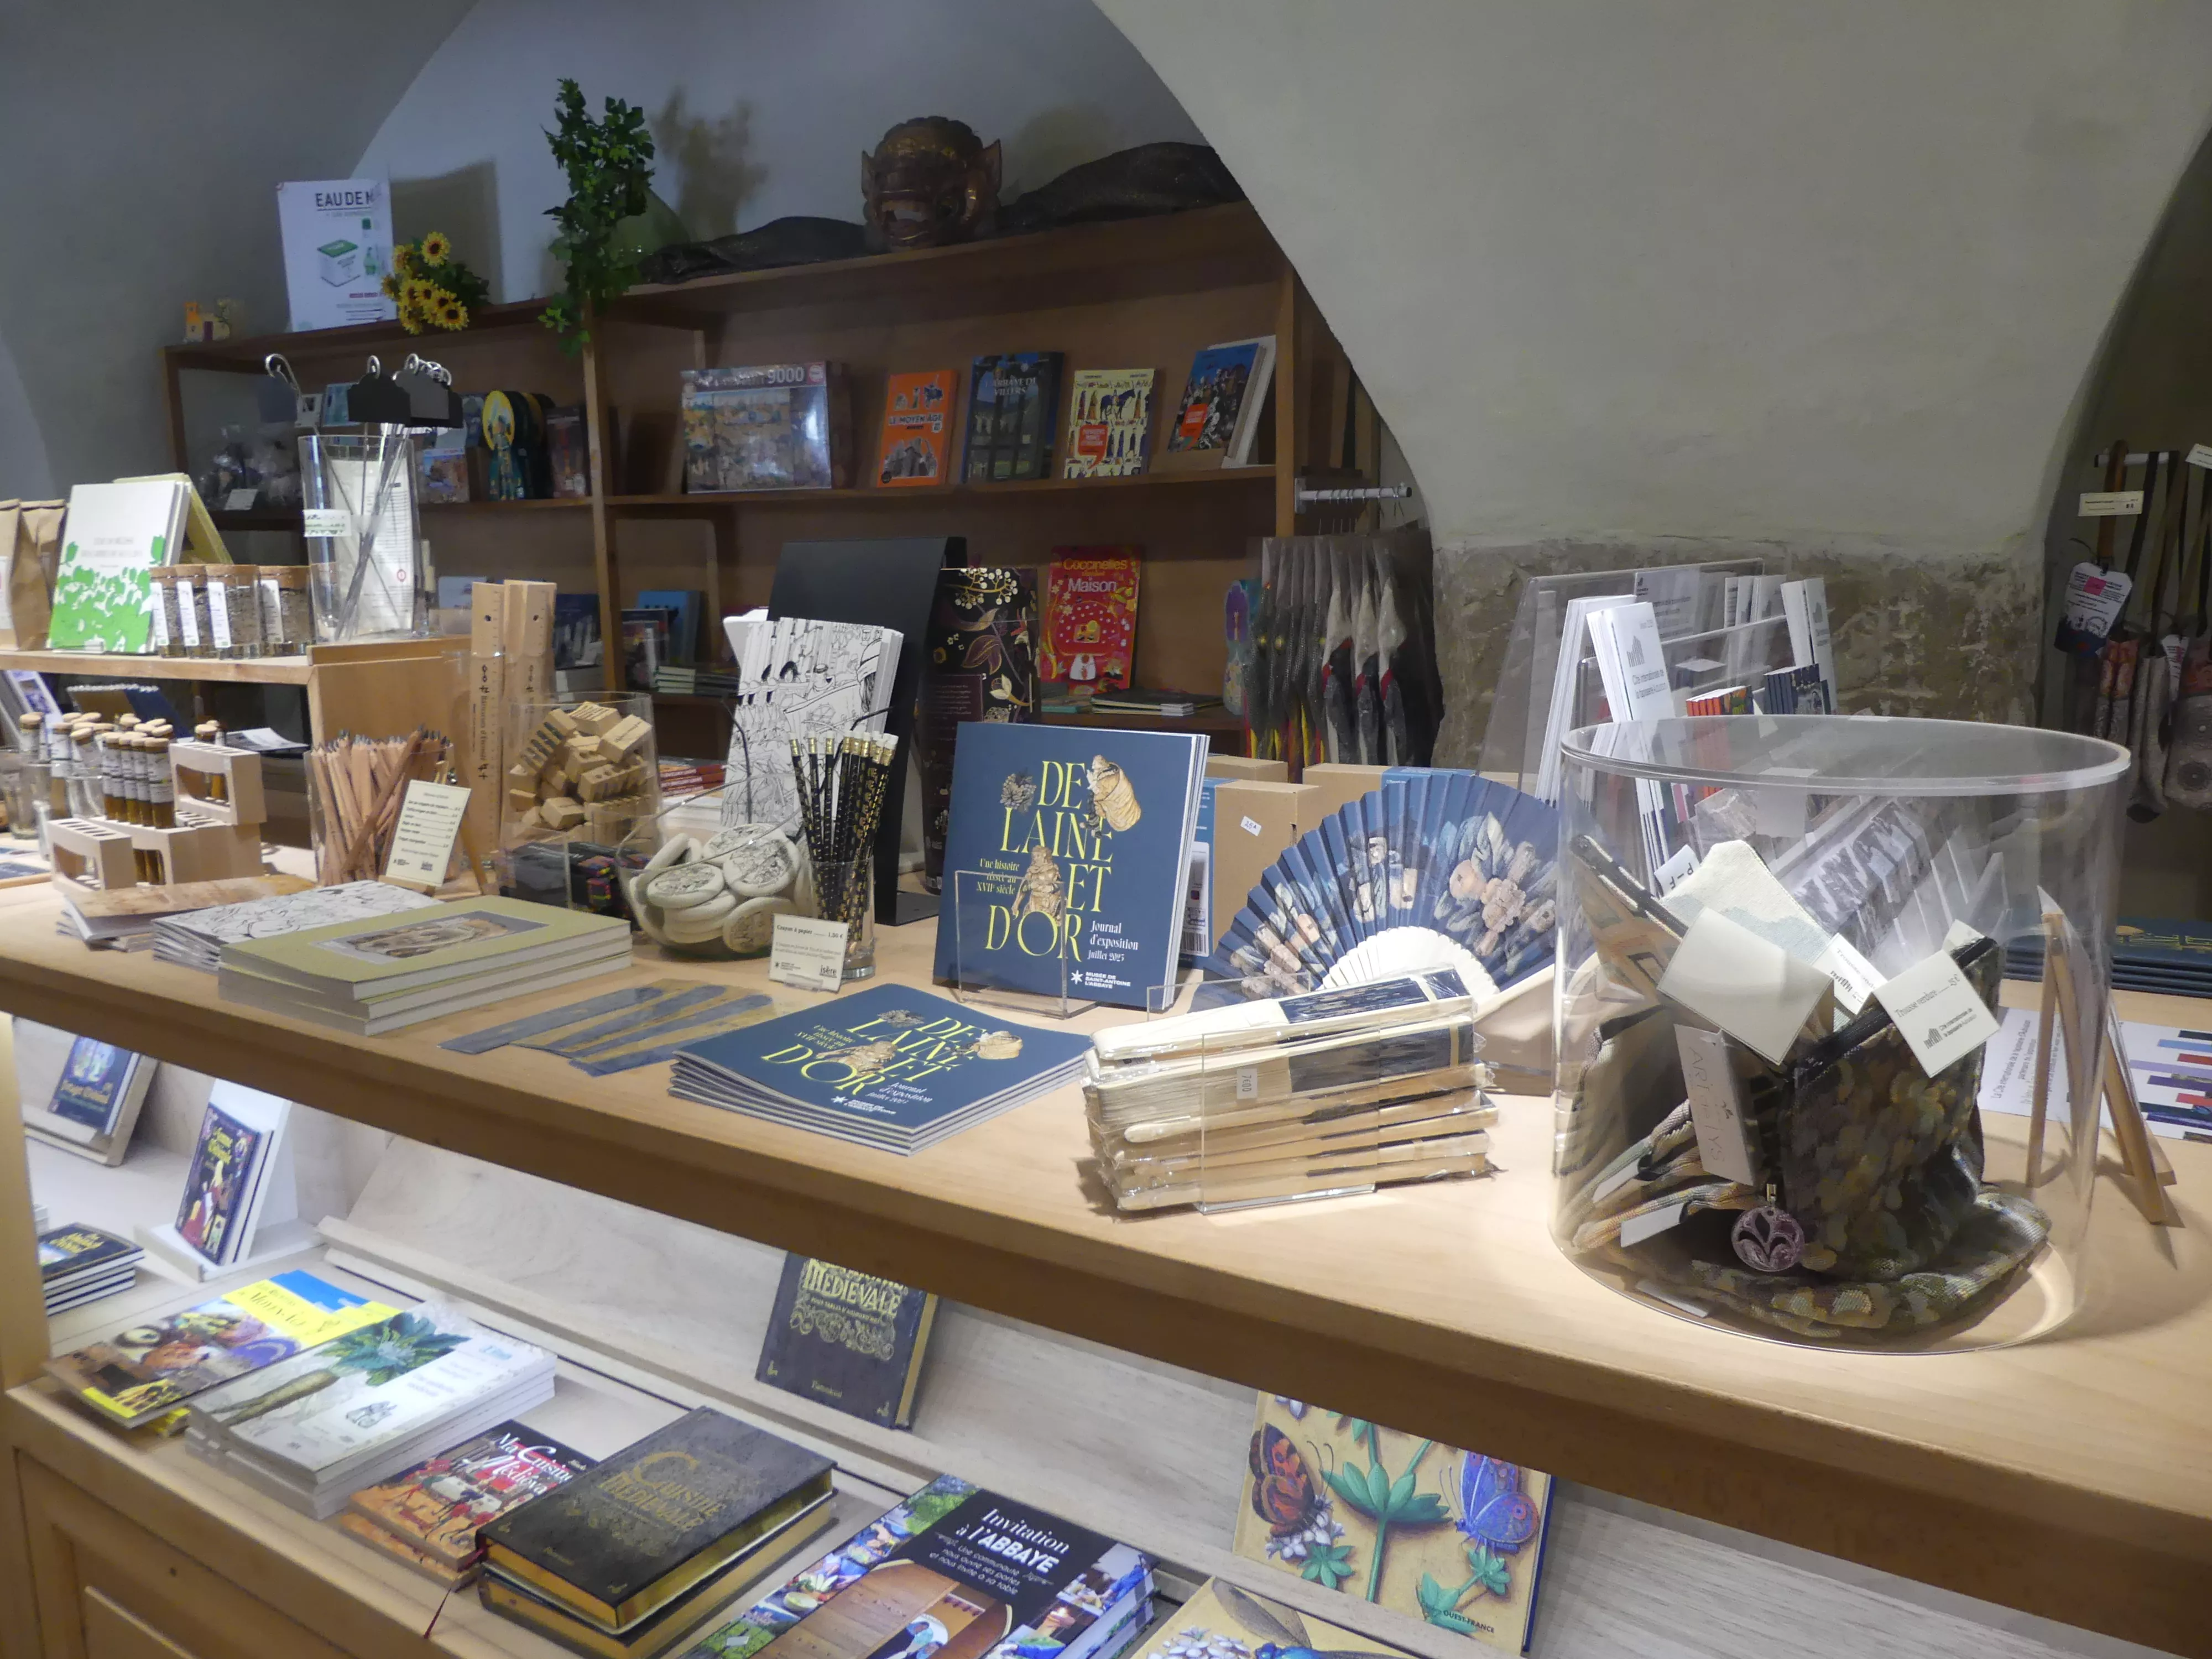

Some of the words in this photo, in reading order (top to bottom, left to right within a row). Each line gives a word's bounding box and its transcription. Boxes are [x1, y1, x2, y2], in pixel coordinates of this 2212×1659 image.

[1068, 577, 1117, 592] Maison
[1037, 760, 1086, 809] DE
[999, 807, 1113, 863] LAINE
[994, 859, 1020, 871] histoire
[1066, 863, 1112, 912] ET
[984, 905, 1082, 963] D'OR
[1090, 920, 1121, 933] Journal
[1090, 933, 1139, 951] d'exposition
[1087, 950, 1107, 960] Juillet
[1108, 952, 1125, 962] 2025
[820, 964, 837, 974] isère
[1085, 976, 1131, 987] SAINT-ANTOINE
[914, 1017, 987, 1042] DE
[846, 1018, 975, 1066] LAINE
[879, 1057, 962, 1082] ET
[499, 1432, 521, 1455] Ma
[981, 1508, 1070, 1554] Invitation
[955, 1523, 970, 1536] à
[967, 1525, 1060, 1573] l'ABBAYE
[1443, 1610, 1495, 1633] OUEST-FRANCE
